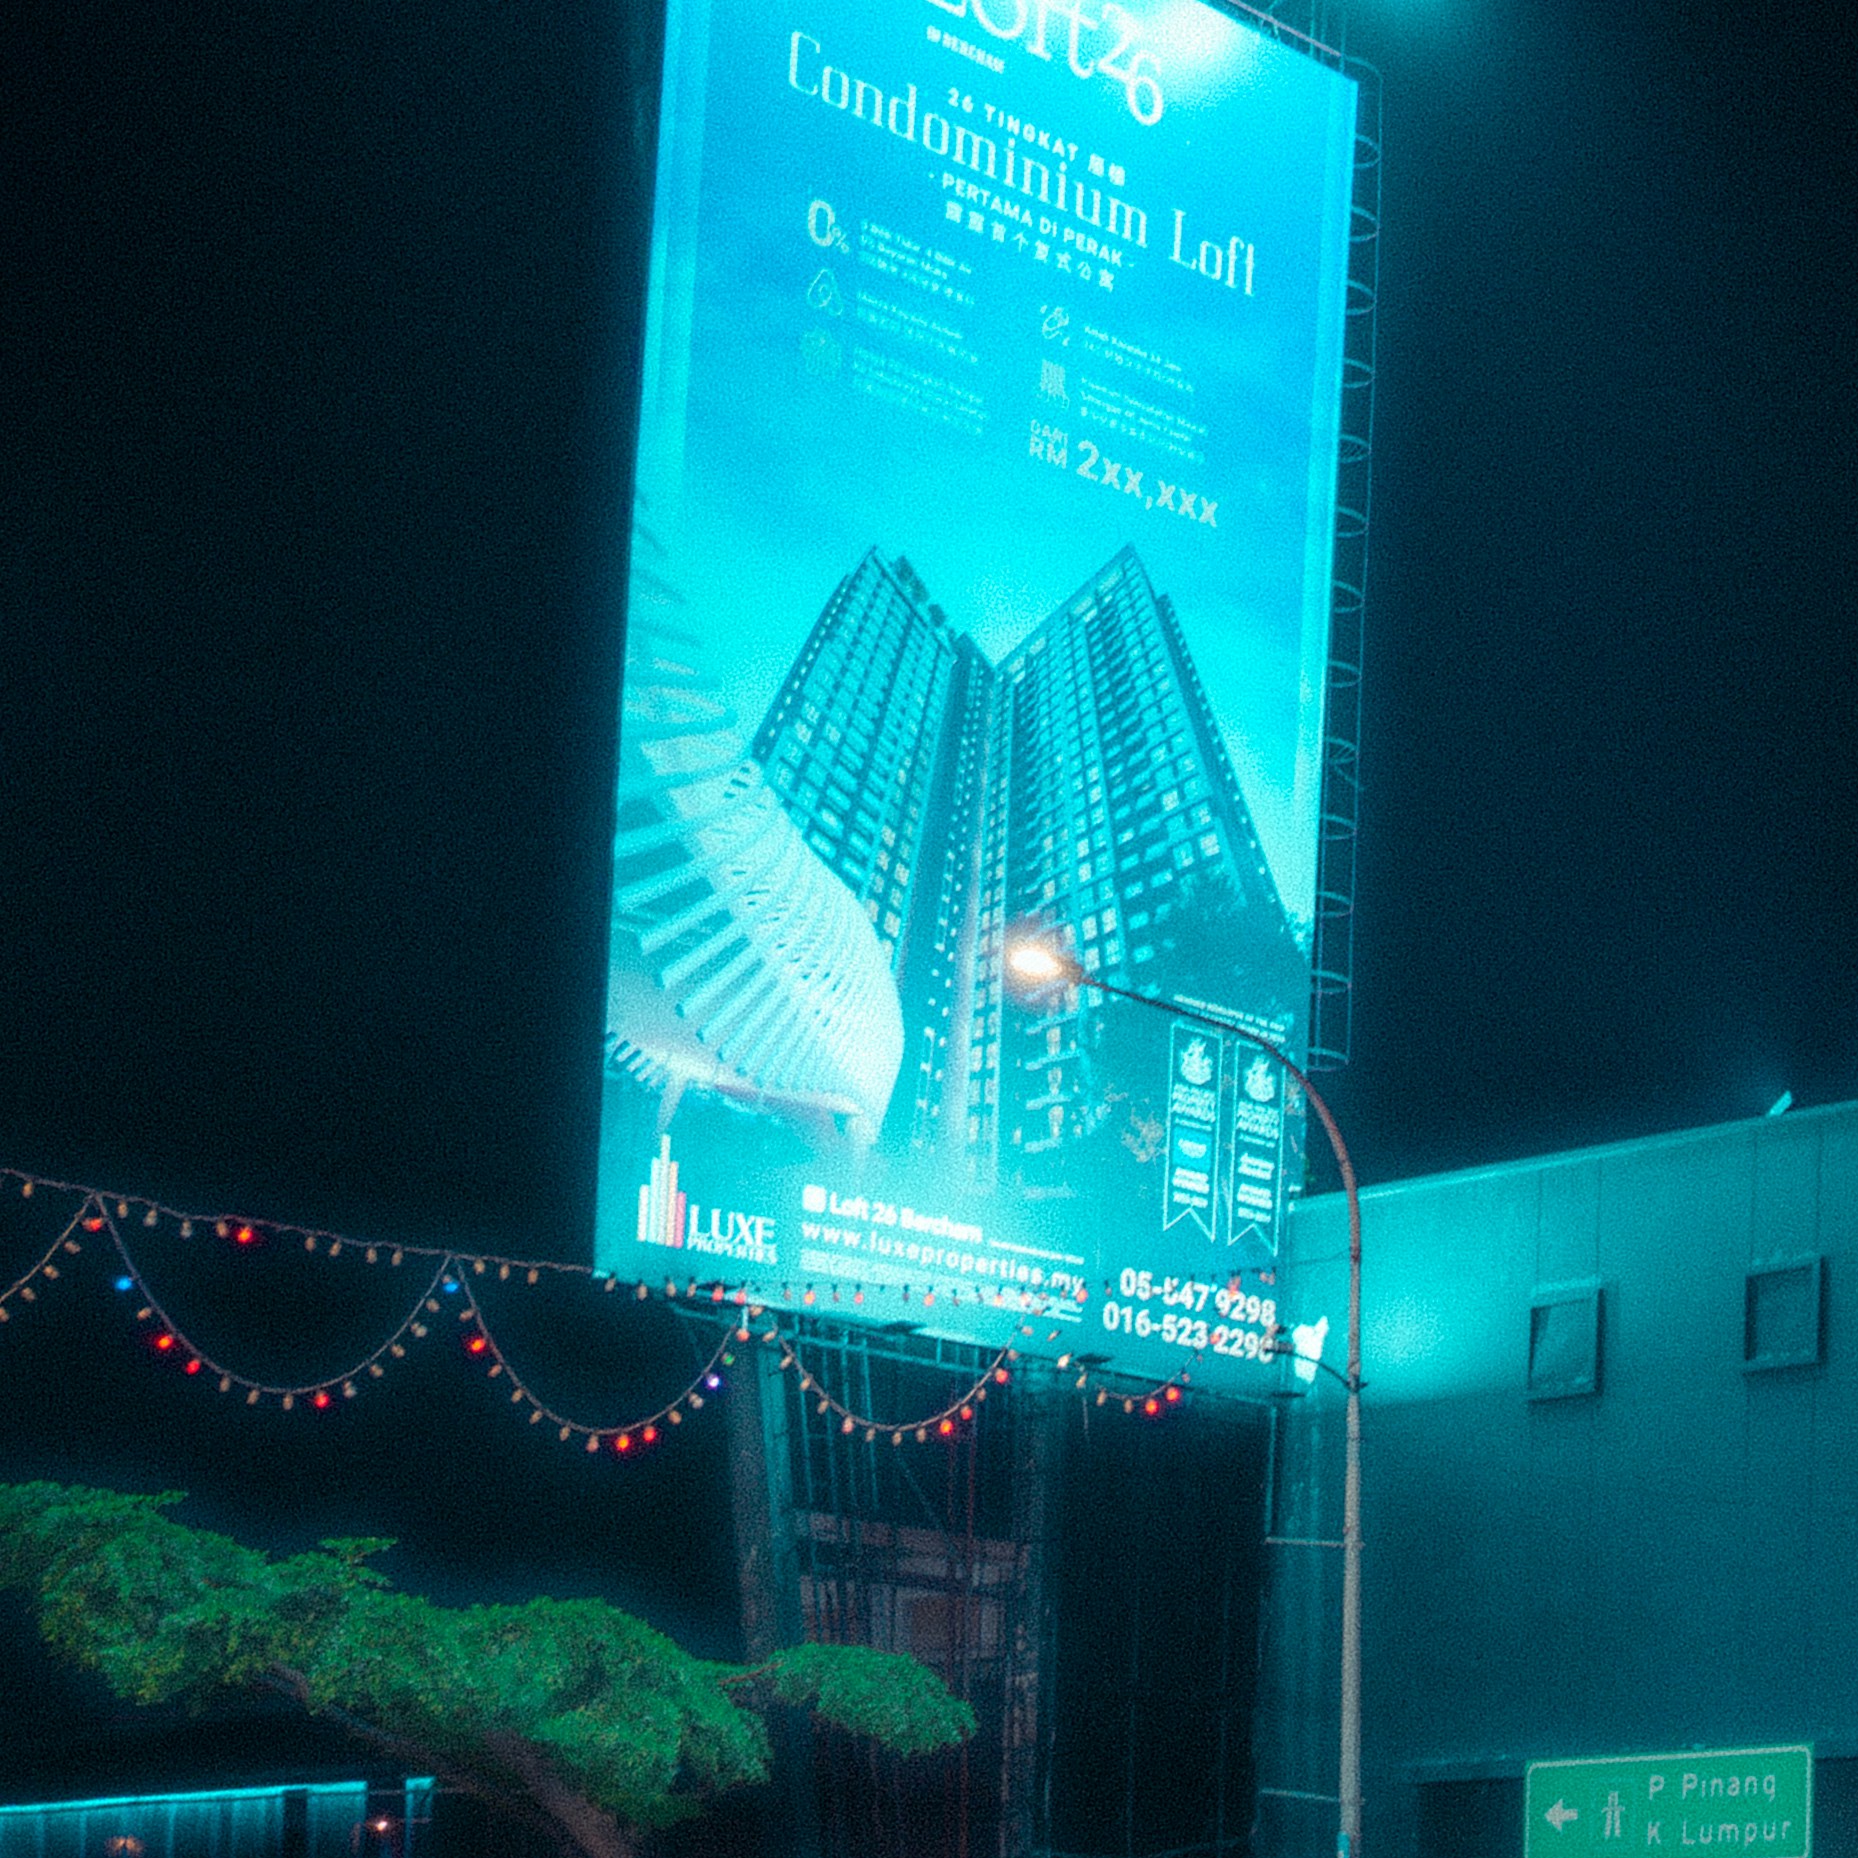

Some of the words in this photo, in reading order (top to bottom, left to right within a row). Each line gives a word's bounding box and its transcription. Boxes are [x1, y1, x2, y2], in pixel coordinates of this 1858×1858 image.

[947, 87, 974, 113] 26
[984, 102, 1079, 162] TINGKAT
[788, 31, 1148, 249] Condominium
[1170, 208, 1256, 296] Loft
[807, 199, 851, 255] 0%
[942, 173, 1032, 228] PERTAMA
[1039, 216, 1058, 239] DI
[1063, 226, 1124, 268] PERAK
[1029, 434, 1068, 469] RM
[690, 1204, 776, 1247] LUXE
[829, 1191, 869, 1221] Loft
[872, 1201, 898, 1226] 26
[801, 1221, 1086, 1297] www.luxeproperties.my
[1102, 1301, 1208, 1350] 016-523
[1649, 1774, 1665, 1800] P
[1682, 1772, 1776, 1801] Pinang
[1647, 1820, 1661, 1845] K
[1681, 1819, 1792, 1847] Lumpur
